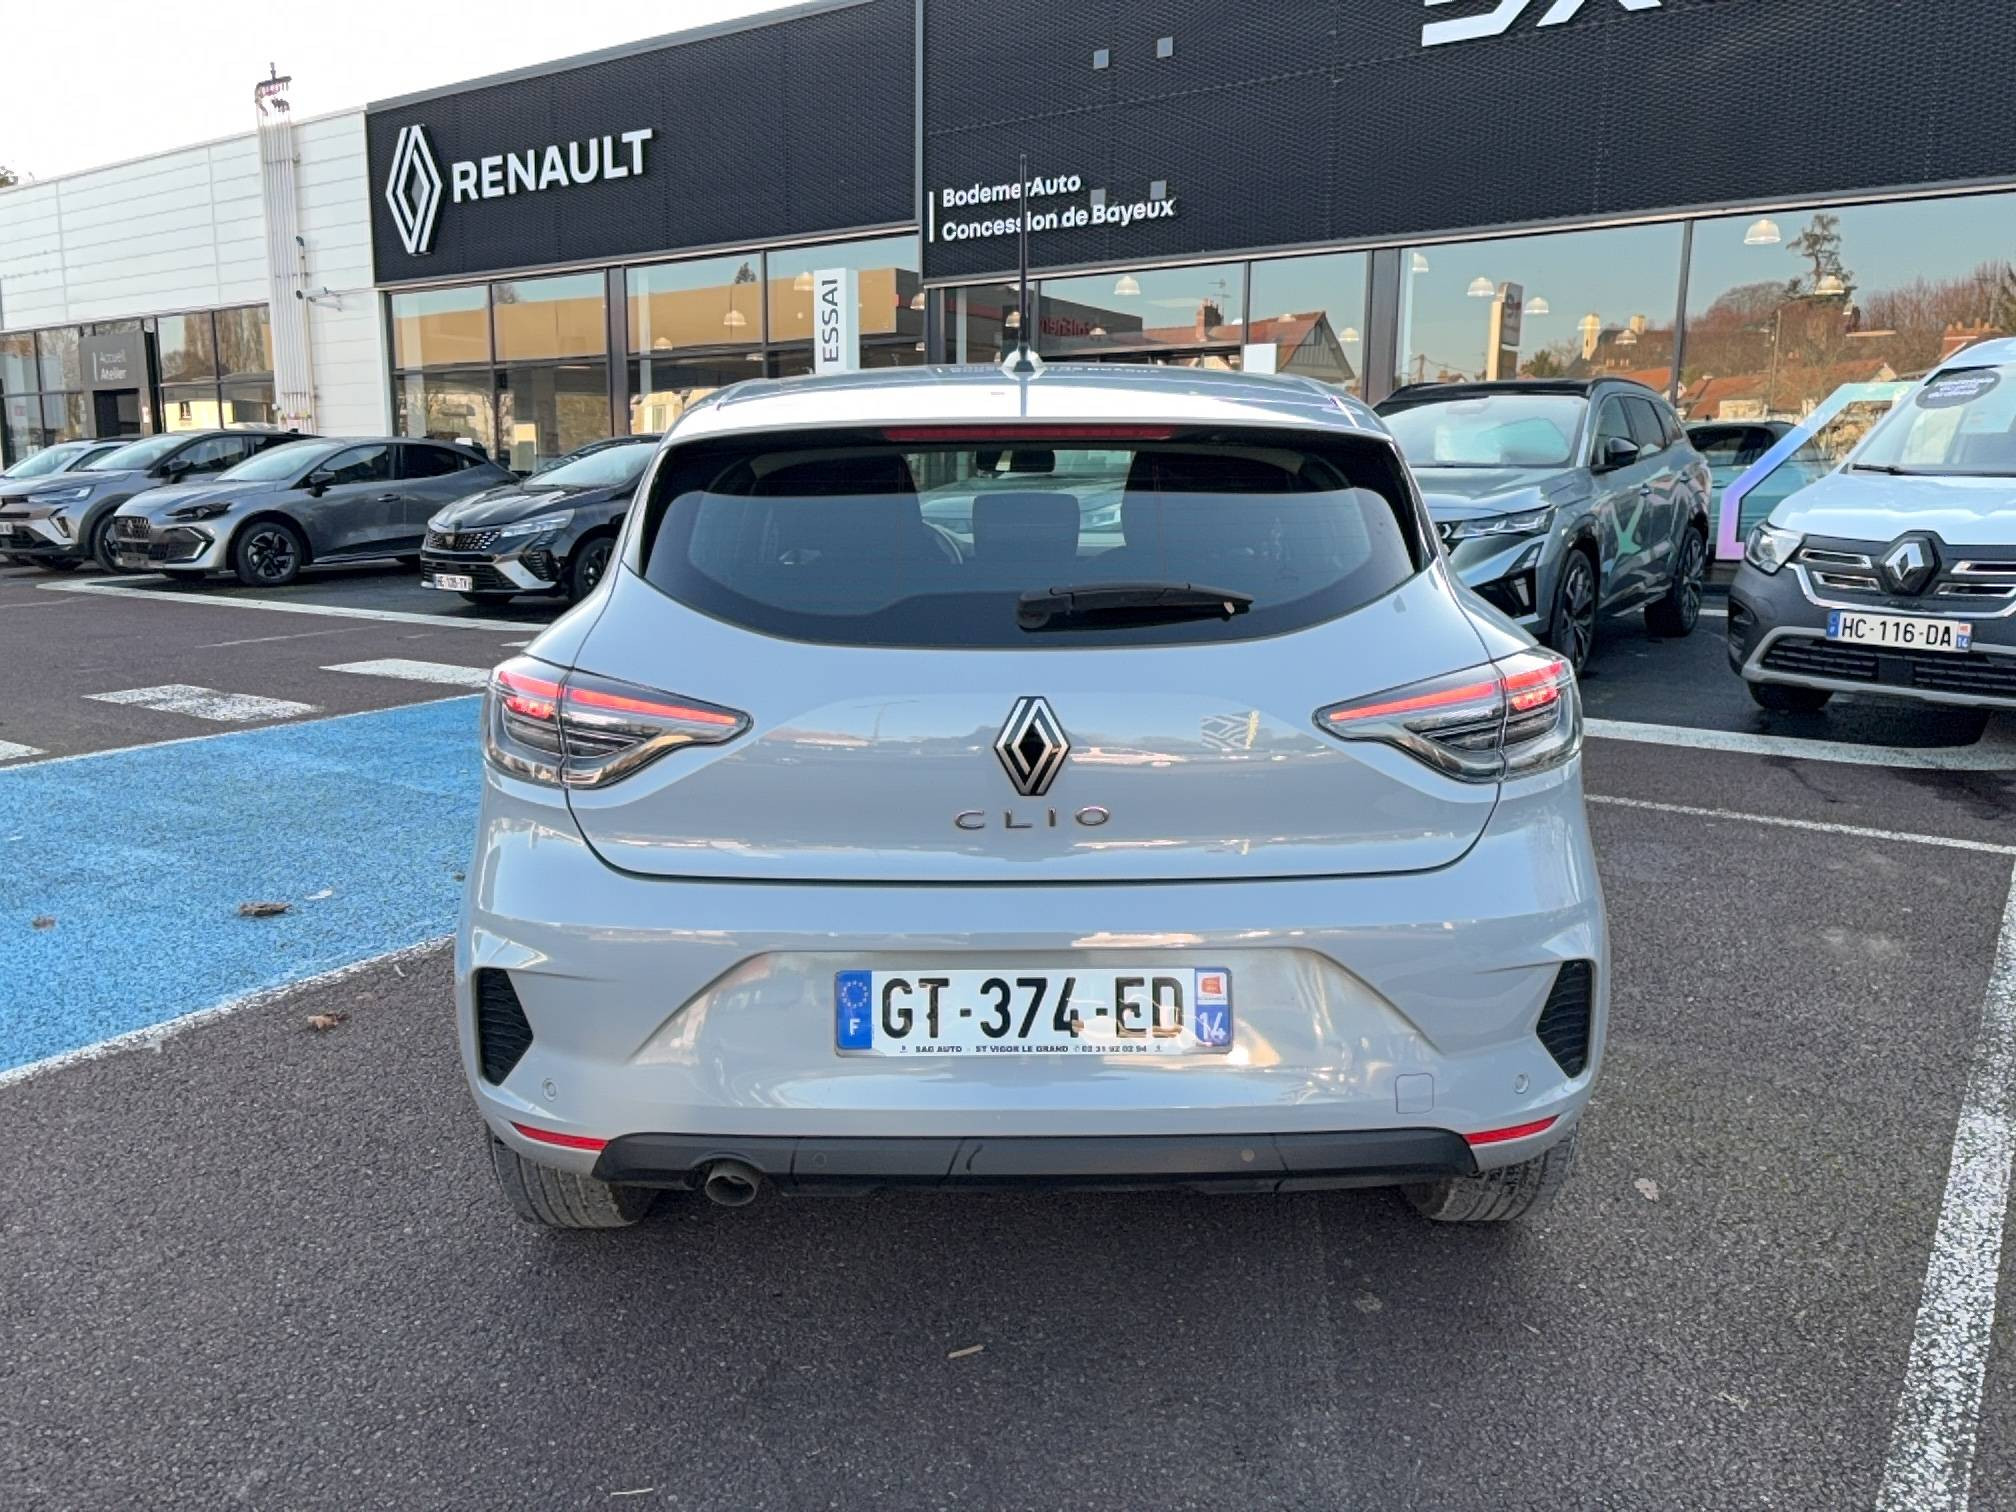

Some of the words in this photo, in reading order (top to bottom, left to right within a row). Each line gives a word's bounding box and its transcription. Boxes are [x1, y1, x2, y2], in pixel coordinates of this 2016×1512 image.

[452, 128, 653, 203] RENAULT
[942, 174, 1082, 208] BodemerAuto
[1061, 206, 1089, 228] de
[1092, 198, 1175, 227] Bayeux
[821, 279, 839, 363] ESSAI
[1841, 617, 1951, 647] HC-116-DA
[954, 806, 1110, 830] CLIO
[881, 976, 1185, 1039] GT-374-ED
[849, 1018, 861, 1036] F
[1199, 1011, 1227, 1041] 14
[937, 1045, 962, 1053] AUTO
[975, 1045, 987, 1053] ST
[990, 1045, 1020, 1053] VIGOR
[1022, 1045, 1033, 1053] LE
[1036, 1045, 1068, 1053] GRAND
